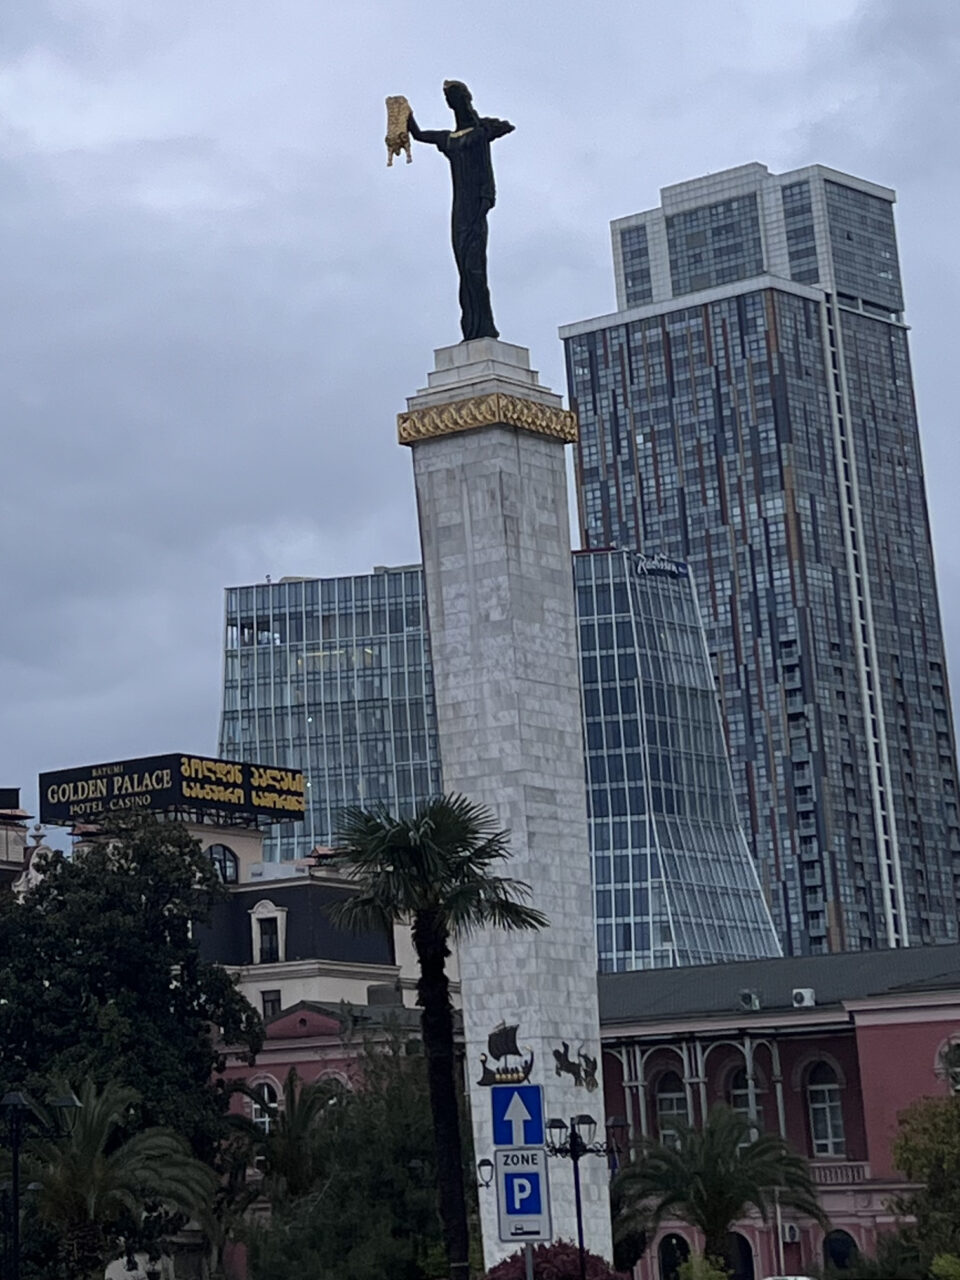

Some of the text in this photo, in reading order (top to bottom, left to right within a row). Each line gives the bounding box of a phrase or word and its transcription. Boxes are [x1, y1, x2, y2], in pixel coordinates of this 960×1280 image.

[48, 769, 173, 803] GOLDEN PALACE
[69, 794, 151, 816] HOTEL CASINO
[503, 1154, 538, 1166] ZONE
[513, 1178, 532, 1209] P
